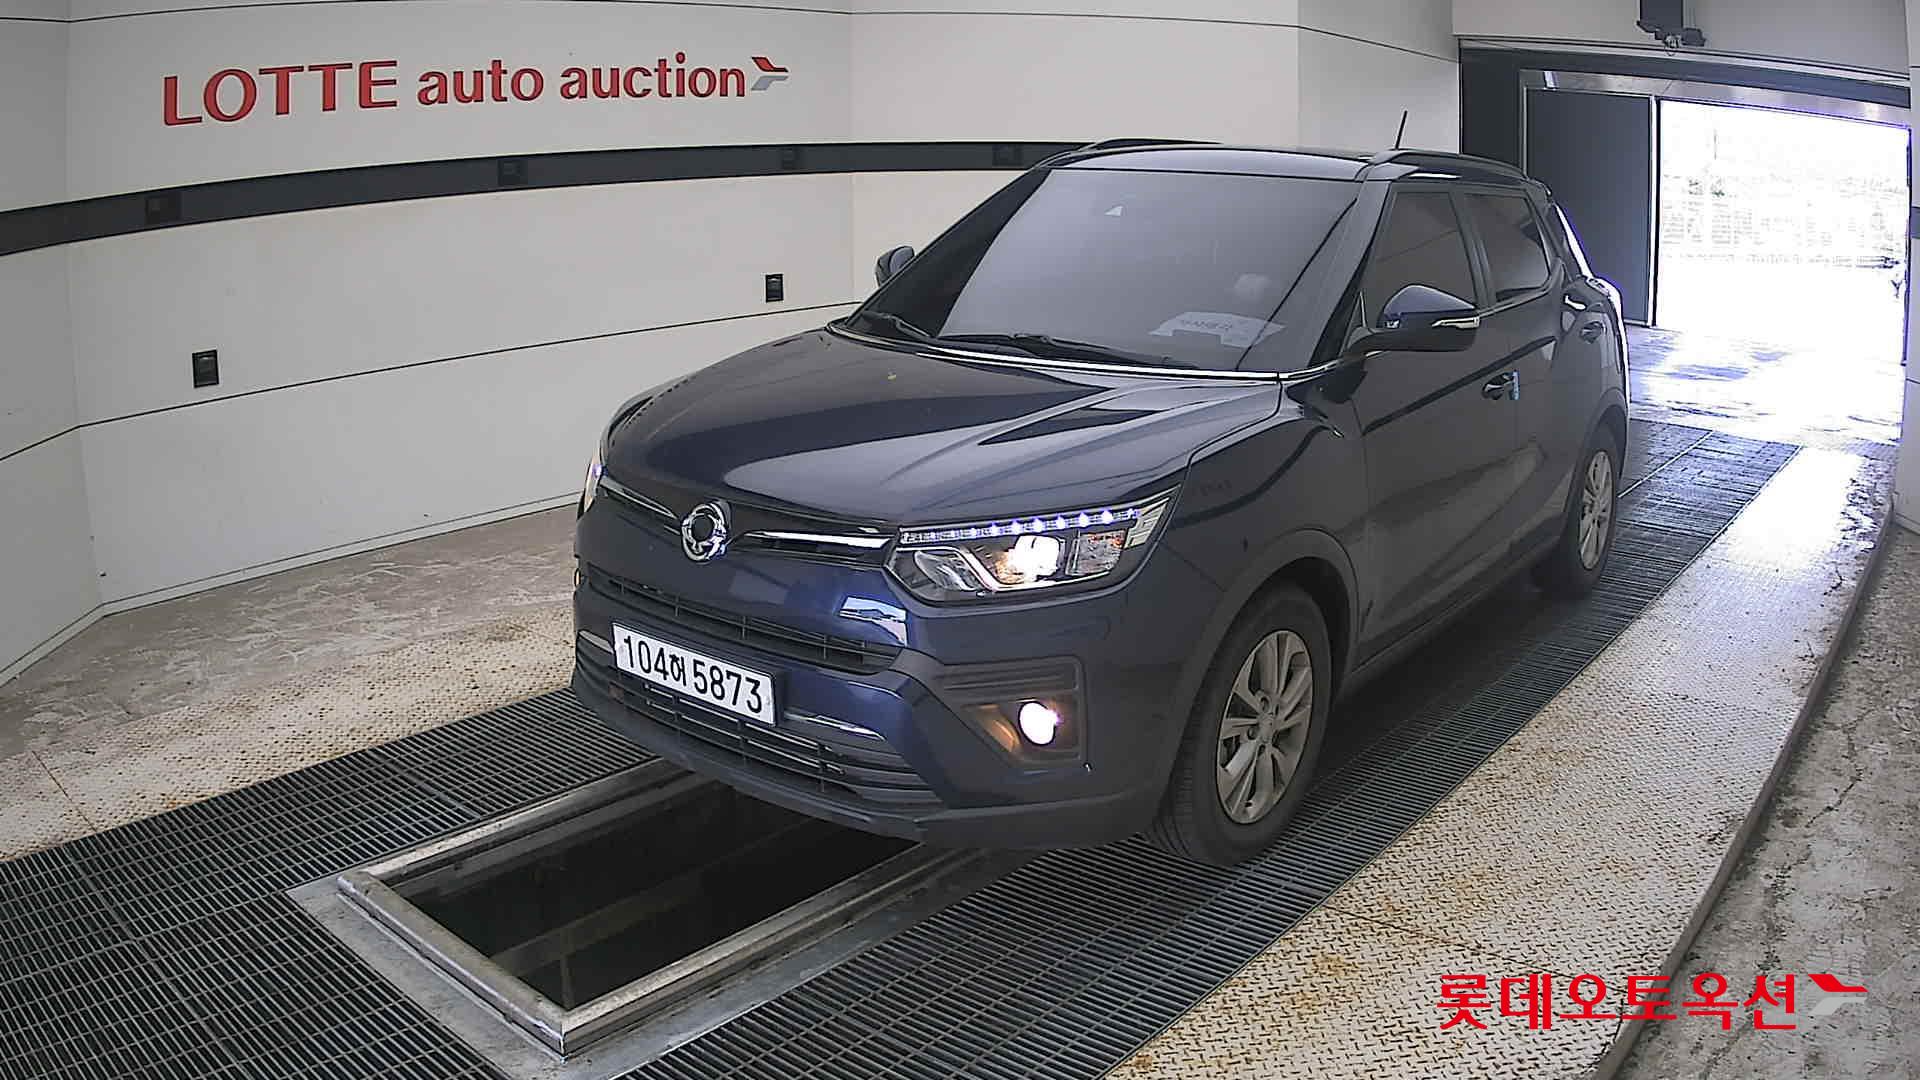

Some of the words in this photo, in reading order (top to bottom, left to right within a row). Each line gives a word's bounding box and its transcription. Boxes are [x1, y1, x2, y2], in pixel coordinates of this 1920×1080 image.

[163, 60, 399, 126] LOTTE
[417, 59, 545, 106] auto
[560, 52, 747, 99] auction
[693, 658, 763, 714] 5873
